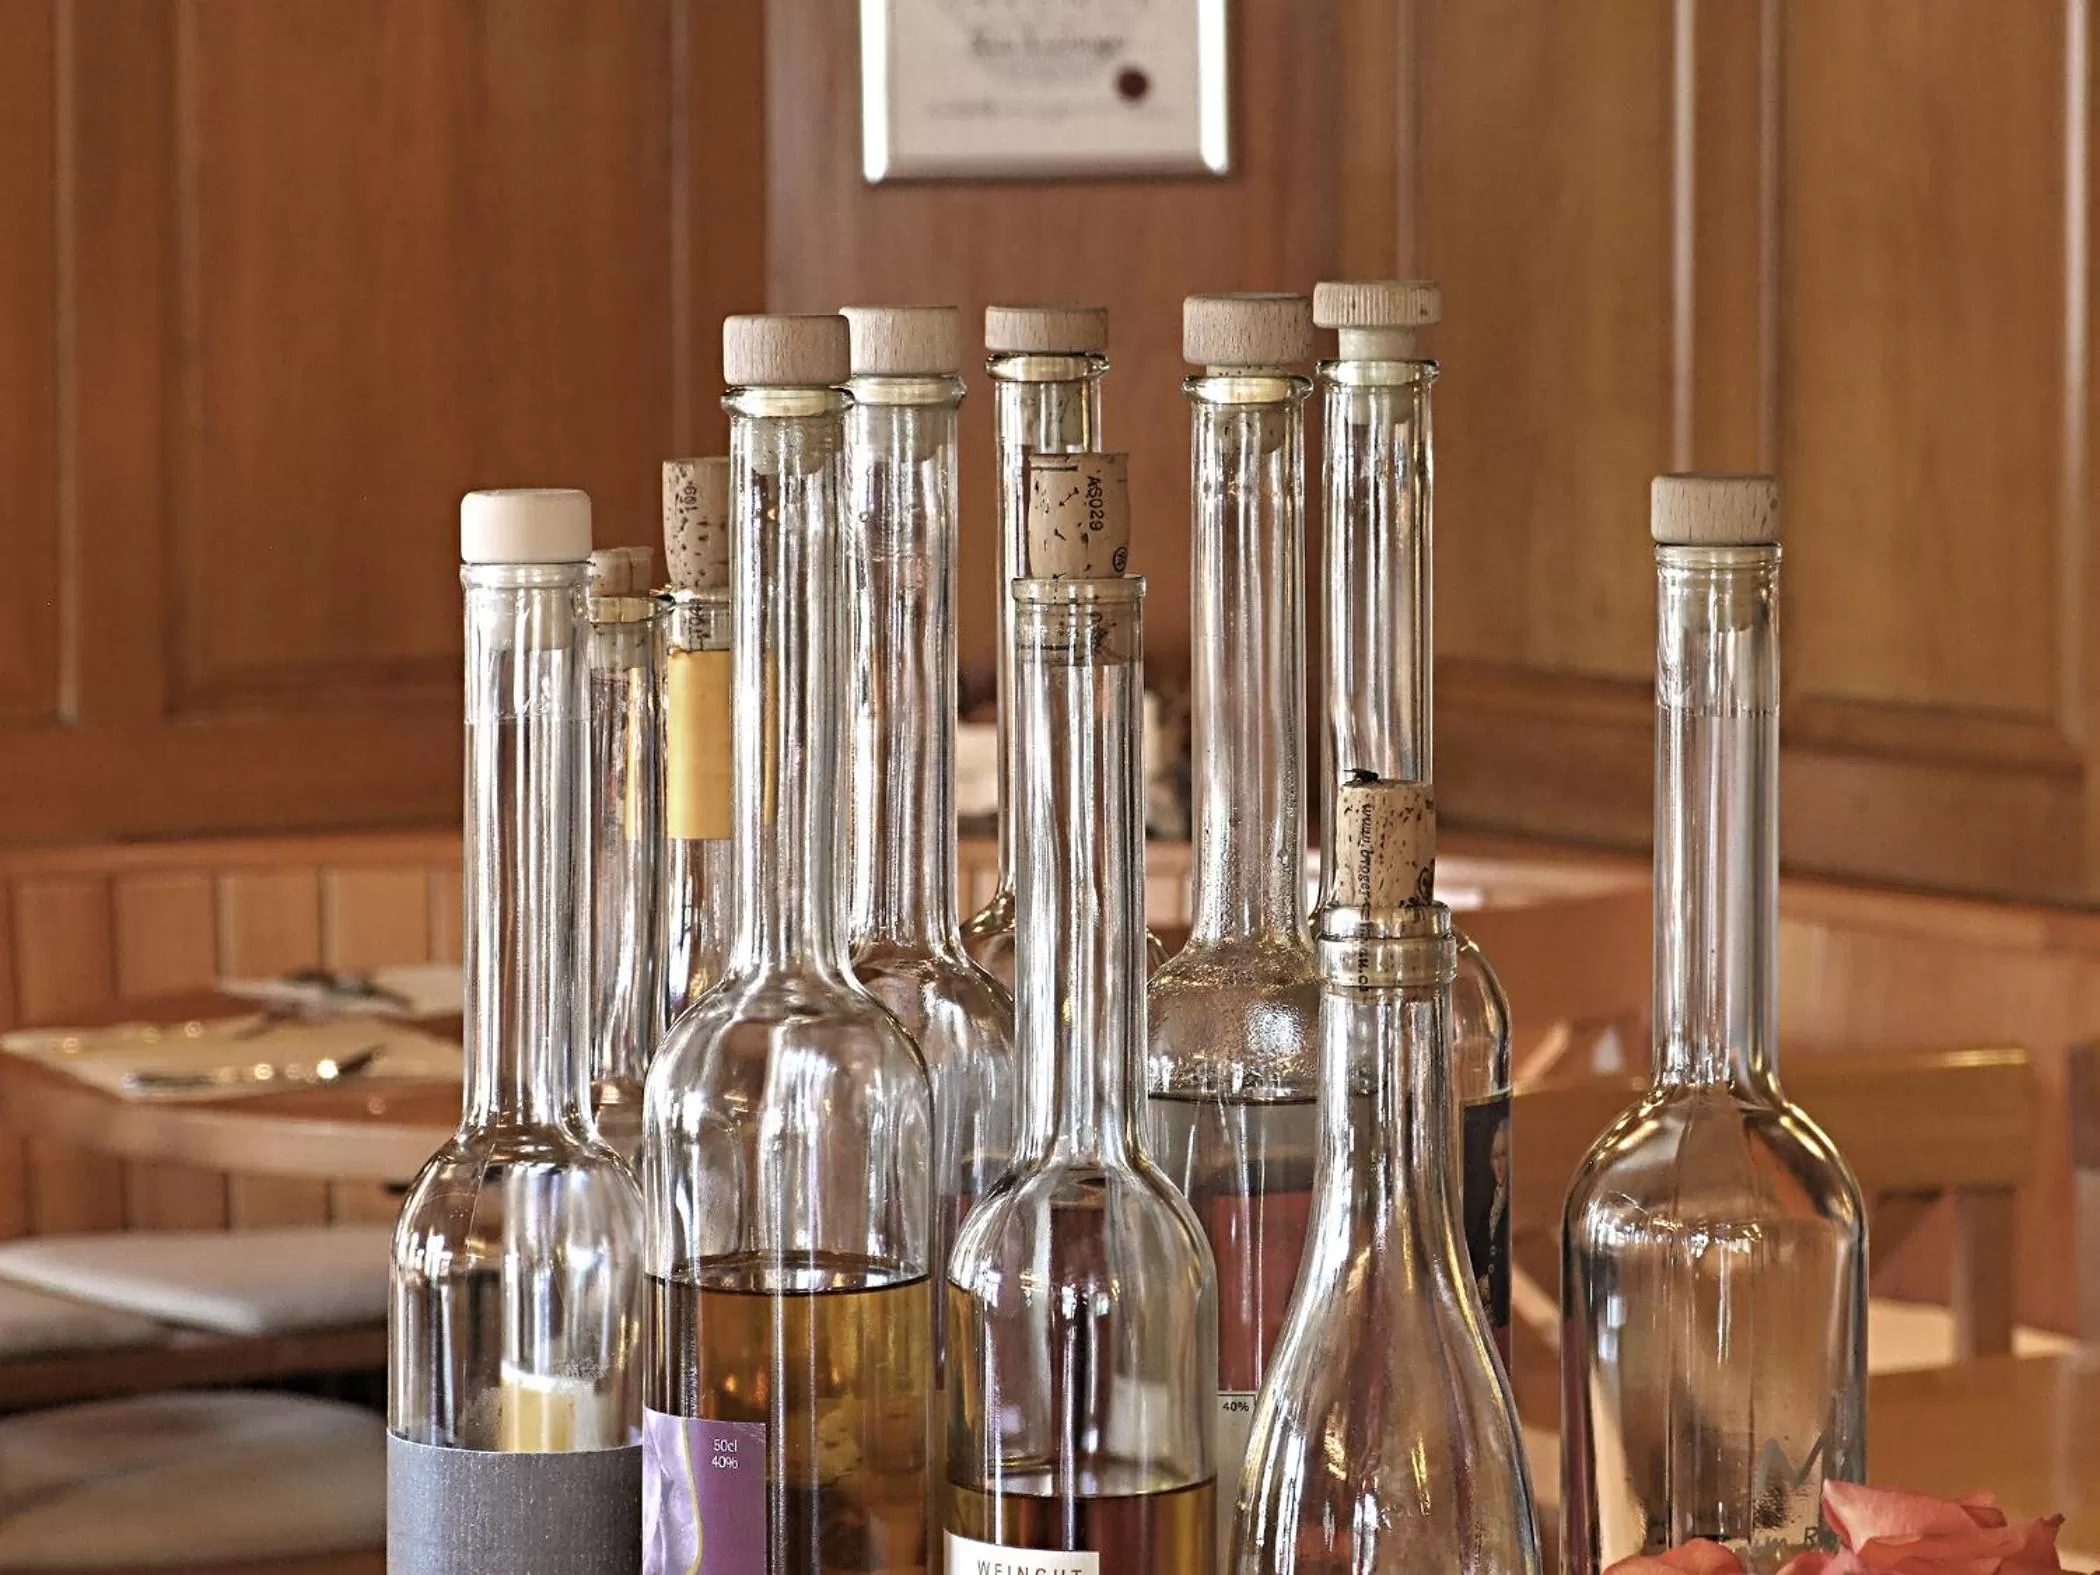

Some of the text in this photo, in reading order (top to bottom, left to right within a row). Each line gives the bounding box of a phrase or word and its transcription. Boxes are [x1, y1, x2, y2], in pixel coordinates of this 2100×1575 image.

[1222, 1401, 1249, 1412] 40%
[713, 1438, 738, 1452] 50cl
[711, 1455, 739, 1469] 40%
